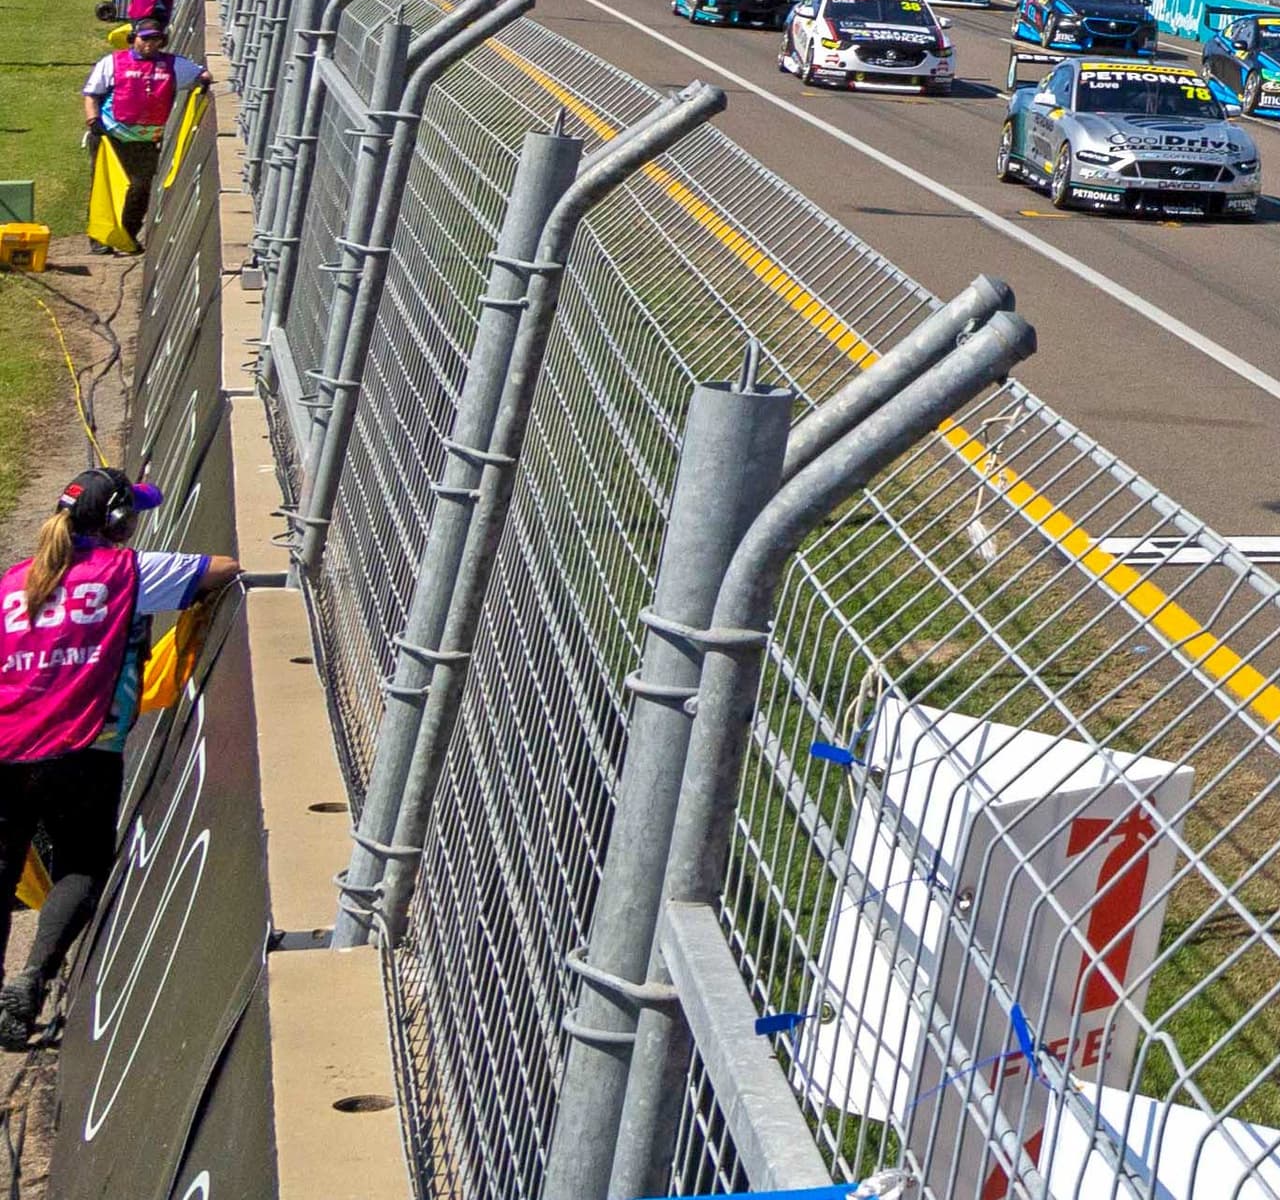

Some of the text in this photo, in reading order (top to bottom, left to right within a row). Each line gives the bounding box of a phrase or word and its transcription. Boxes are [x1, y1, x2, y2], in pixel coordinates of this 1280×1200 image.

[1081, 71, 1206, 87] PETRONAS
[1181, 86, 1212, 100] 78
[1108, 133, 1240, 150] CoolDrive
[1158, 181, 1201, 190] DAYCO
[1072, 187, 1120, 202] PETRONAS
[38, 644, 102, 669] LANE
